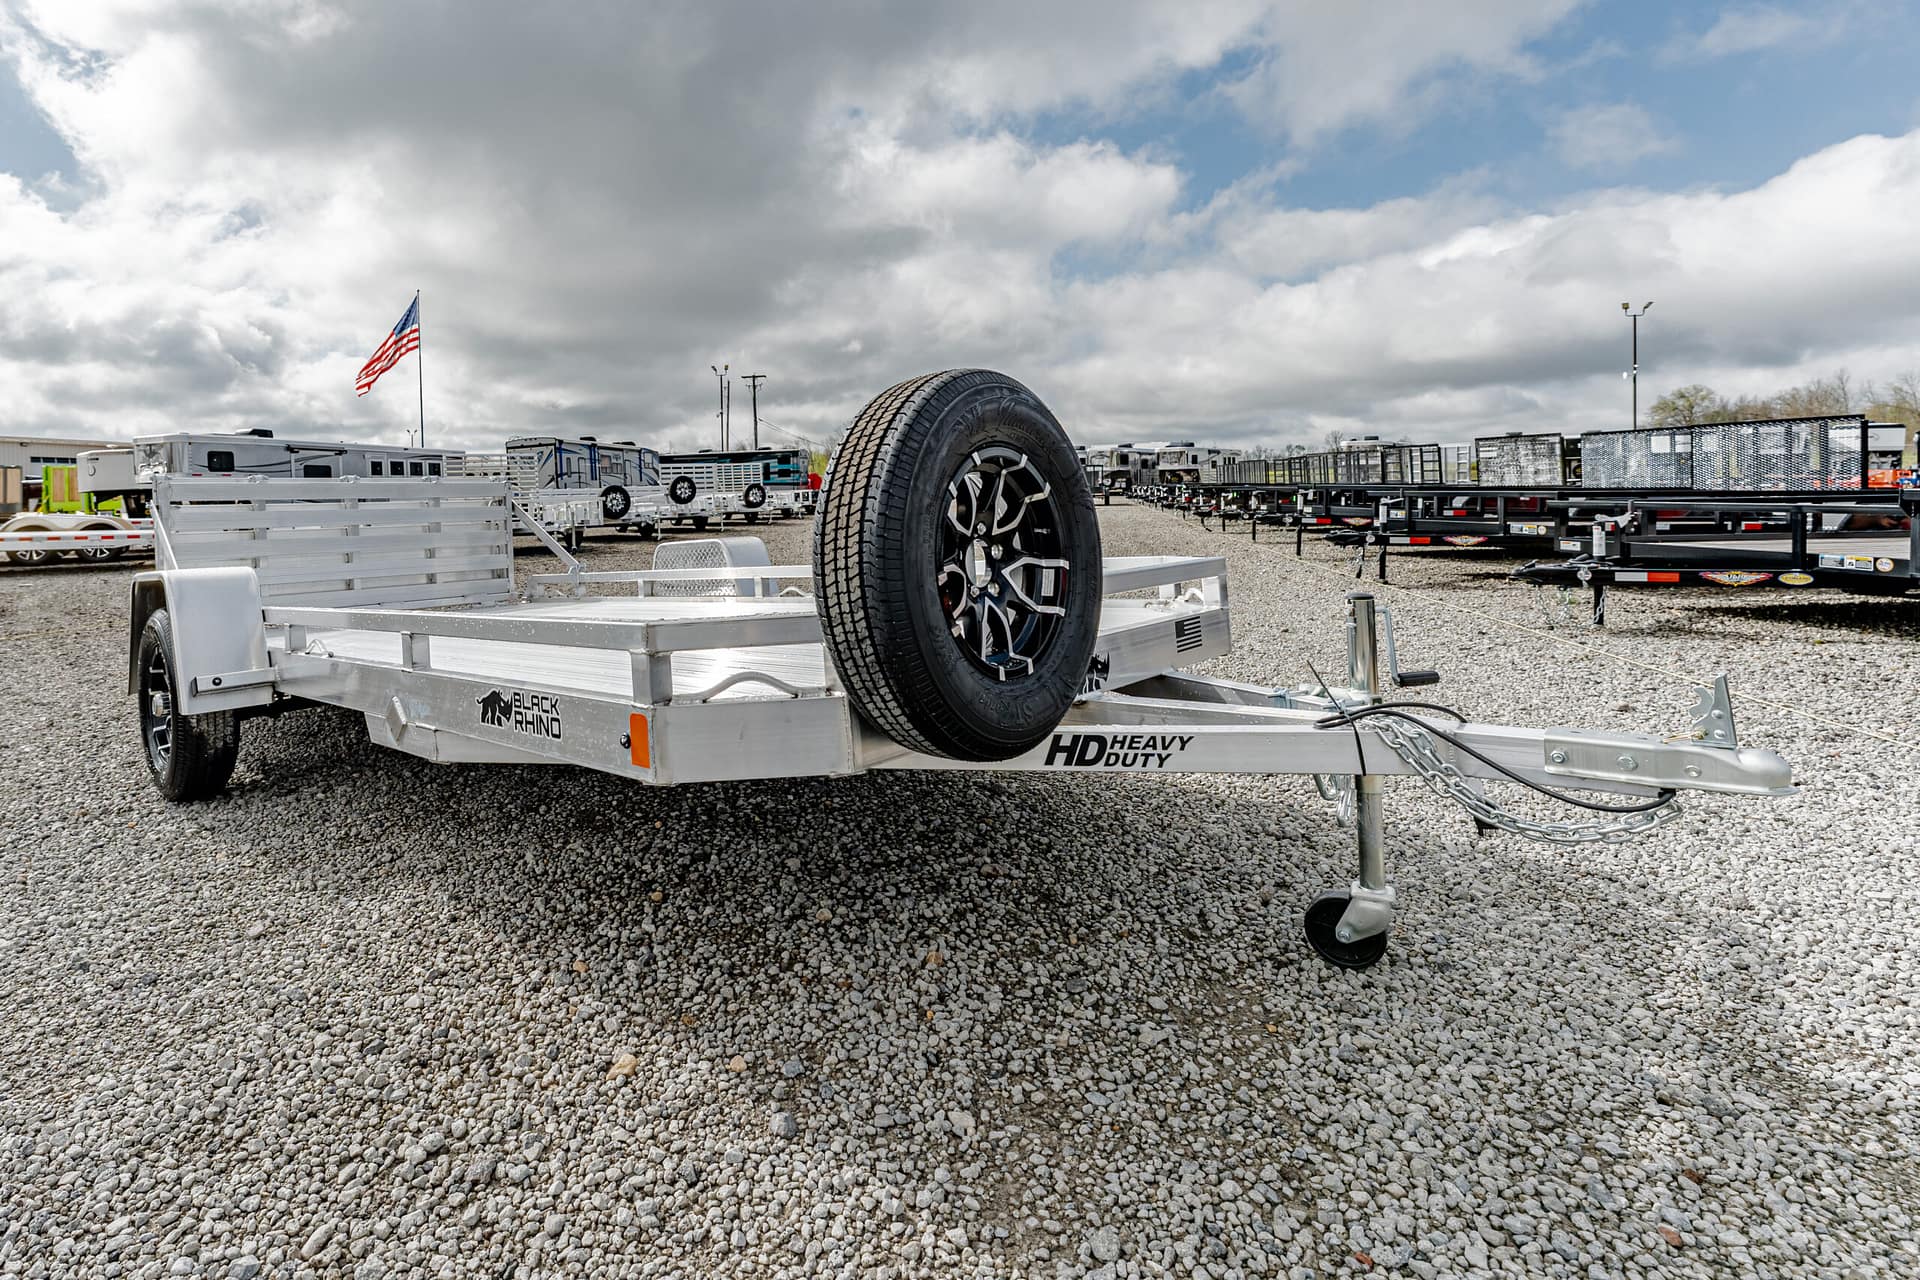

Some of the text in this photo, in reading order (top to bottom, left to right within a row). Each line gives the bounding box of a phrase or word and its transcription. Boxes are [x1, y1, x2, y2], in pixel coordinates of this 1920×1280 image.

[513, 692, 560, 716] BLACK
[514, 710, 562, 739] RHINO
[1044, 734, 1108, 767] HD
[1109, 735, 1195, 751] HEAVY
[1103, 752, 1172, 768] DUTY
